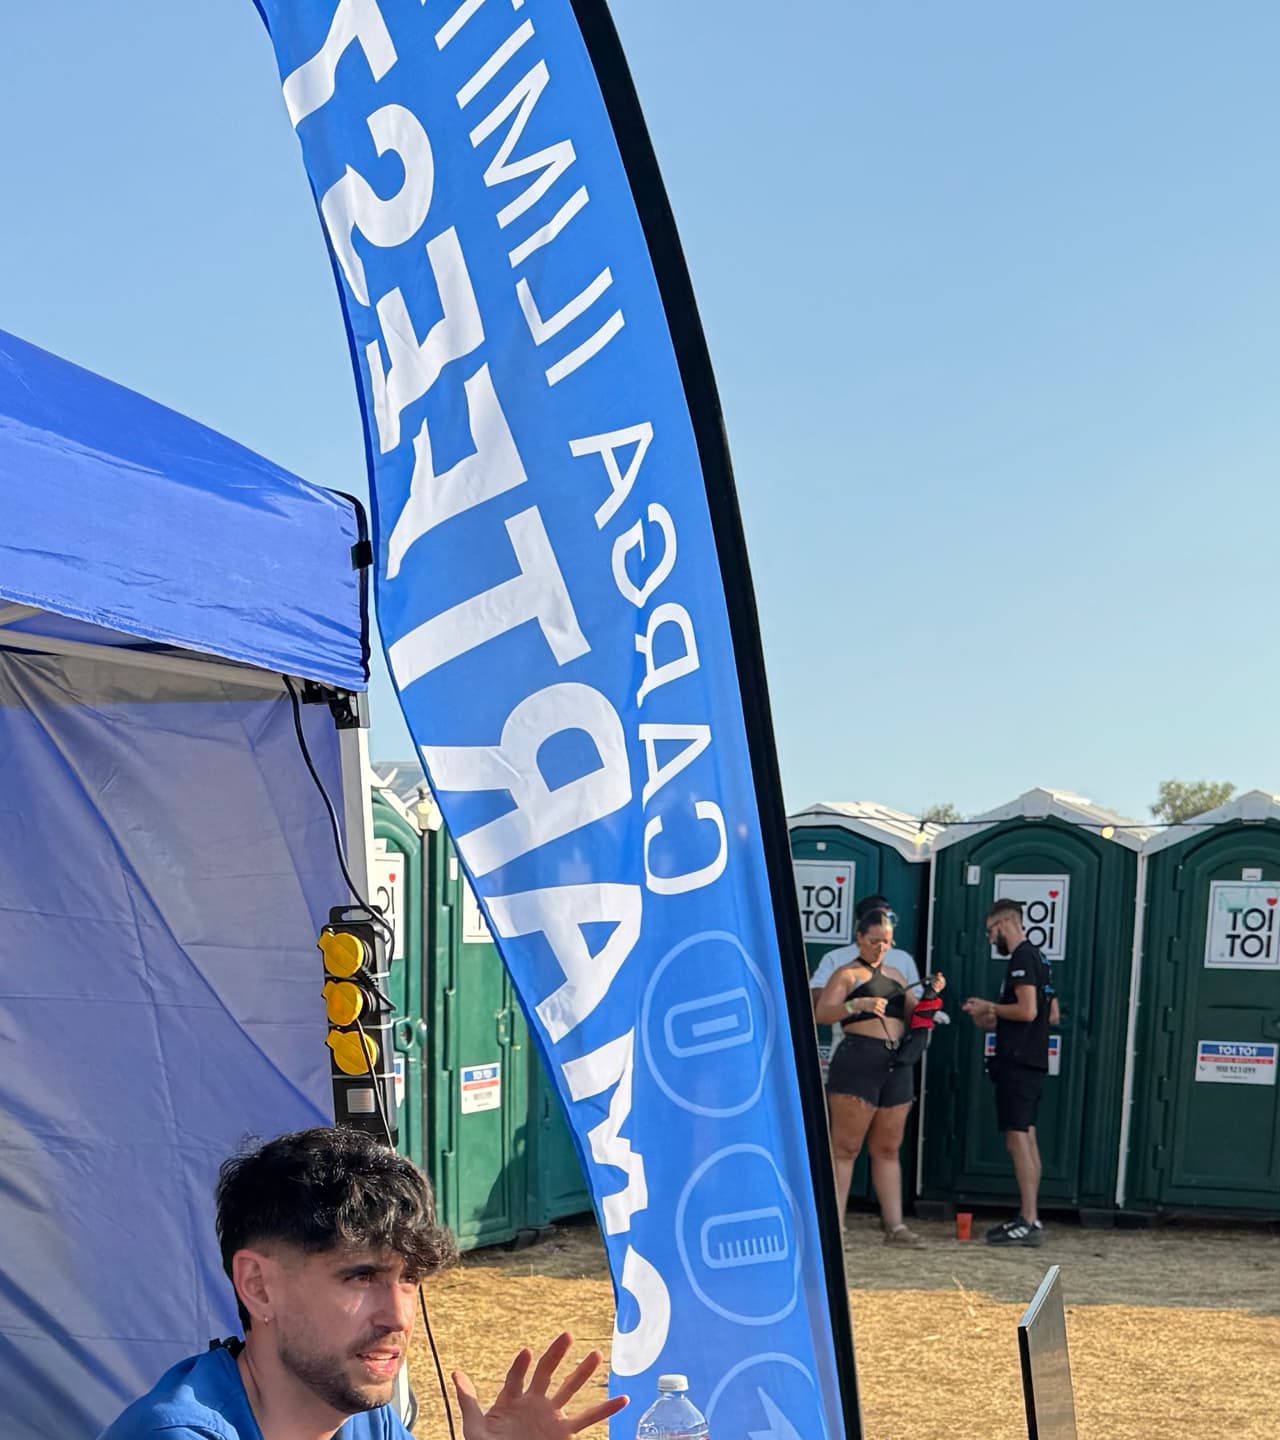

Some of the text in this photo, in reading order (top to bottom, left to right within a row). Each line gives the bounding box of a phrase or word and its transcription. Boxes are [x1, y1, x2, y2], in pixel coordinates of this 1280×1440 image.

[802, 885, 843, 909] TOI
[801, 910, 841, 934] TOI
[1228, 908, 1274, 932] TOI
[1022, 926, 1054, 949] OI
[1225, 934, 1272, 958] TOI
